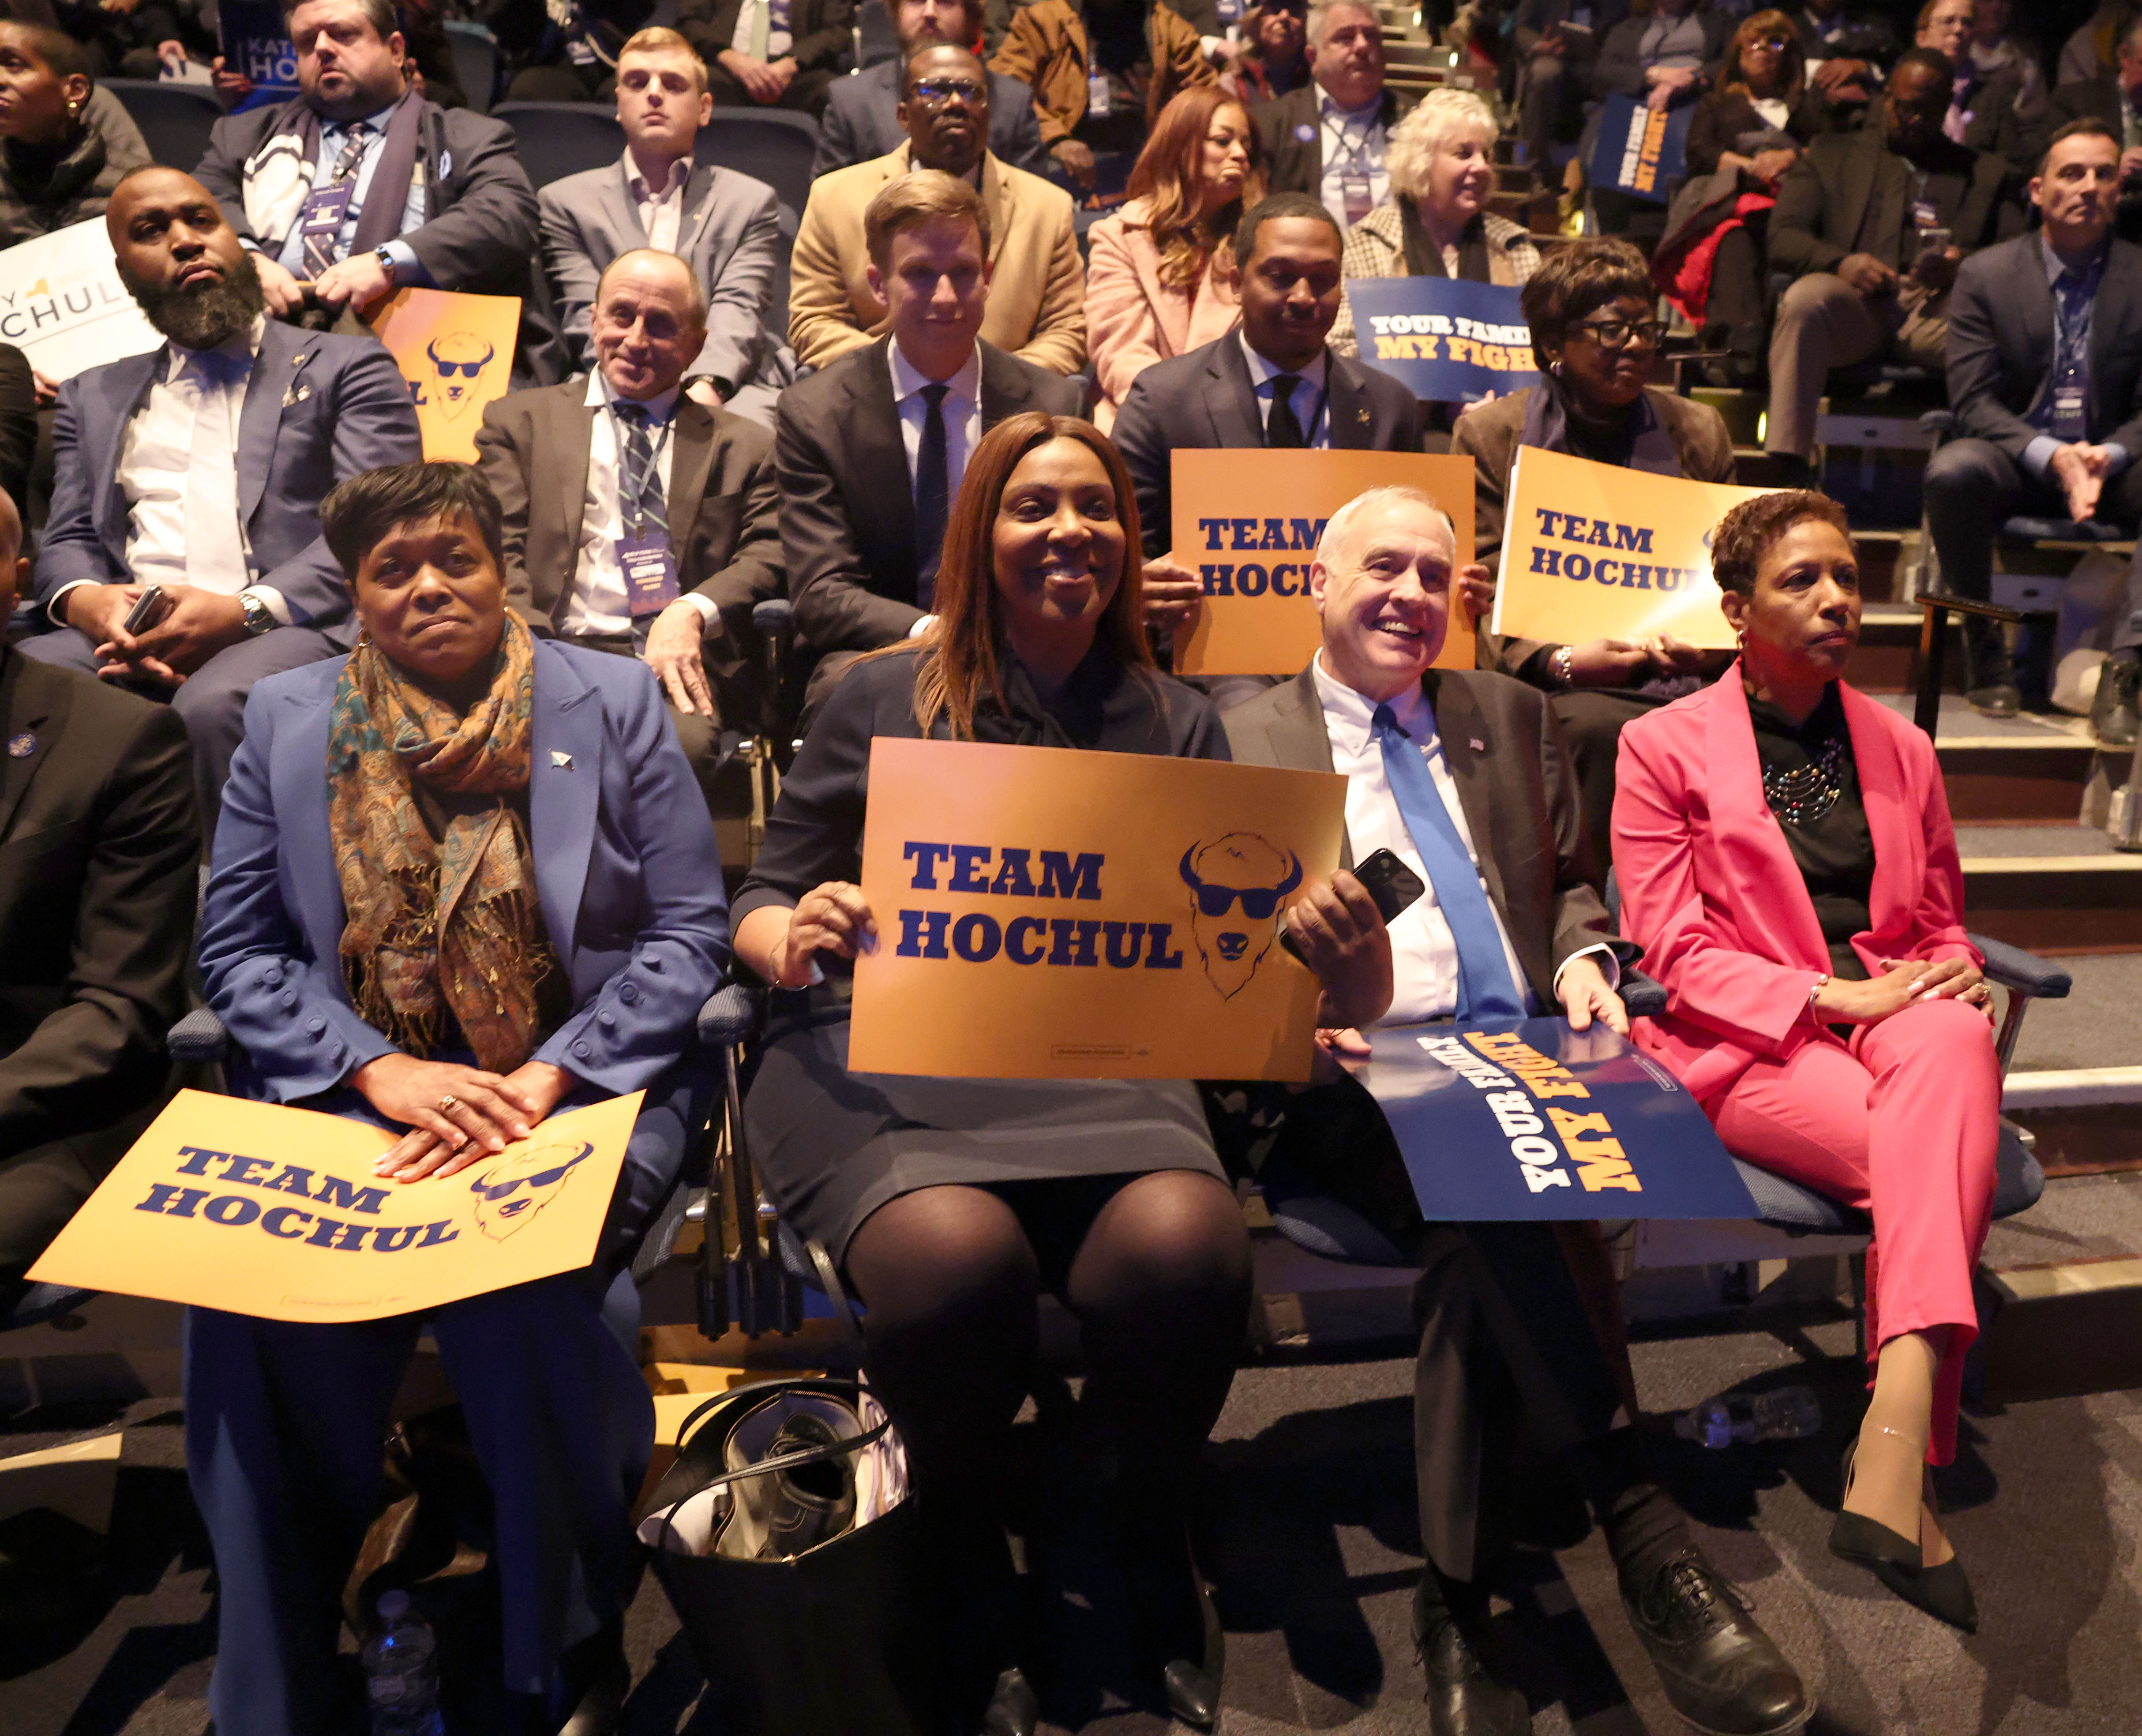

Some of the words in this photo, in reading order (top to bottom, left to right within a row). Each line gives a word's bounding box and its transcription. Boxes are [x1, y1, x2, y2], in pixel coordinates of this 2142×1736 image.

[1369, 315, 1454, 335] YOUR
[1374, 335, 1439, 360] MY
[1199, 519, 1330, 550] TEAM
[1537, 508, 1654, 554] TEAM
[904, 841, 1104, 900] TEAM
[896, 910, 1183, 969] HOCHUL
[1416, 1036, 1517, 1089] FAMILY
[1462, 1031, 1591, 1099] FIGHT
[1485, 1090, 1572, 1193] YOUR
[1545, 1107, 1643, 1192] MY
[177, 1146, 391, 1214] TEAM
[135, 1183, 461, 1252] HOCHUL
